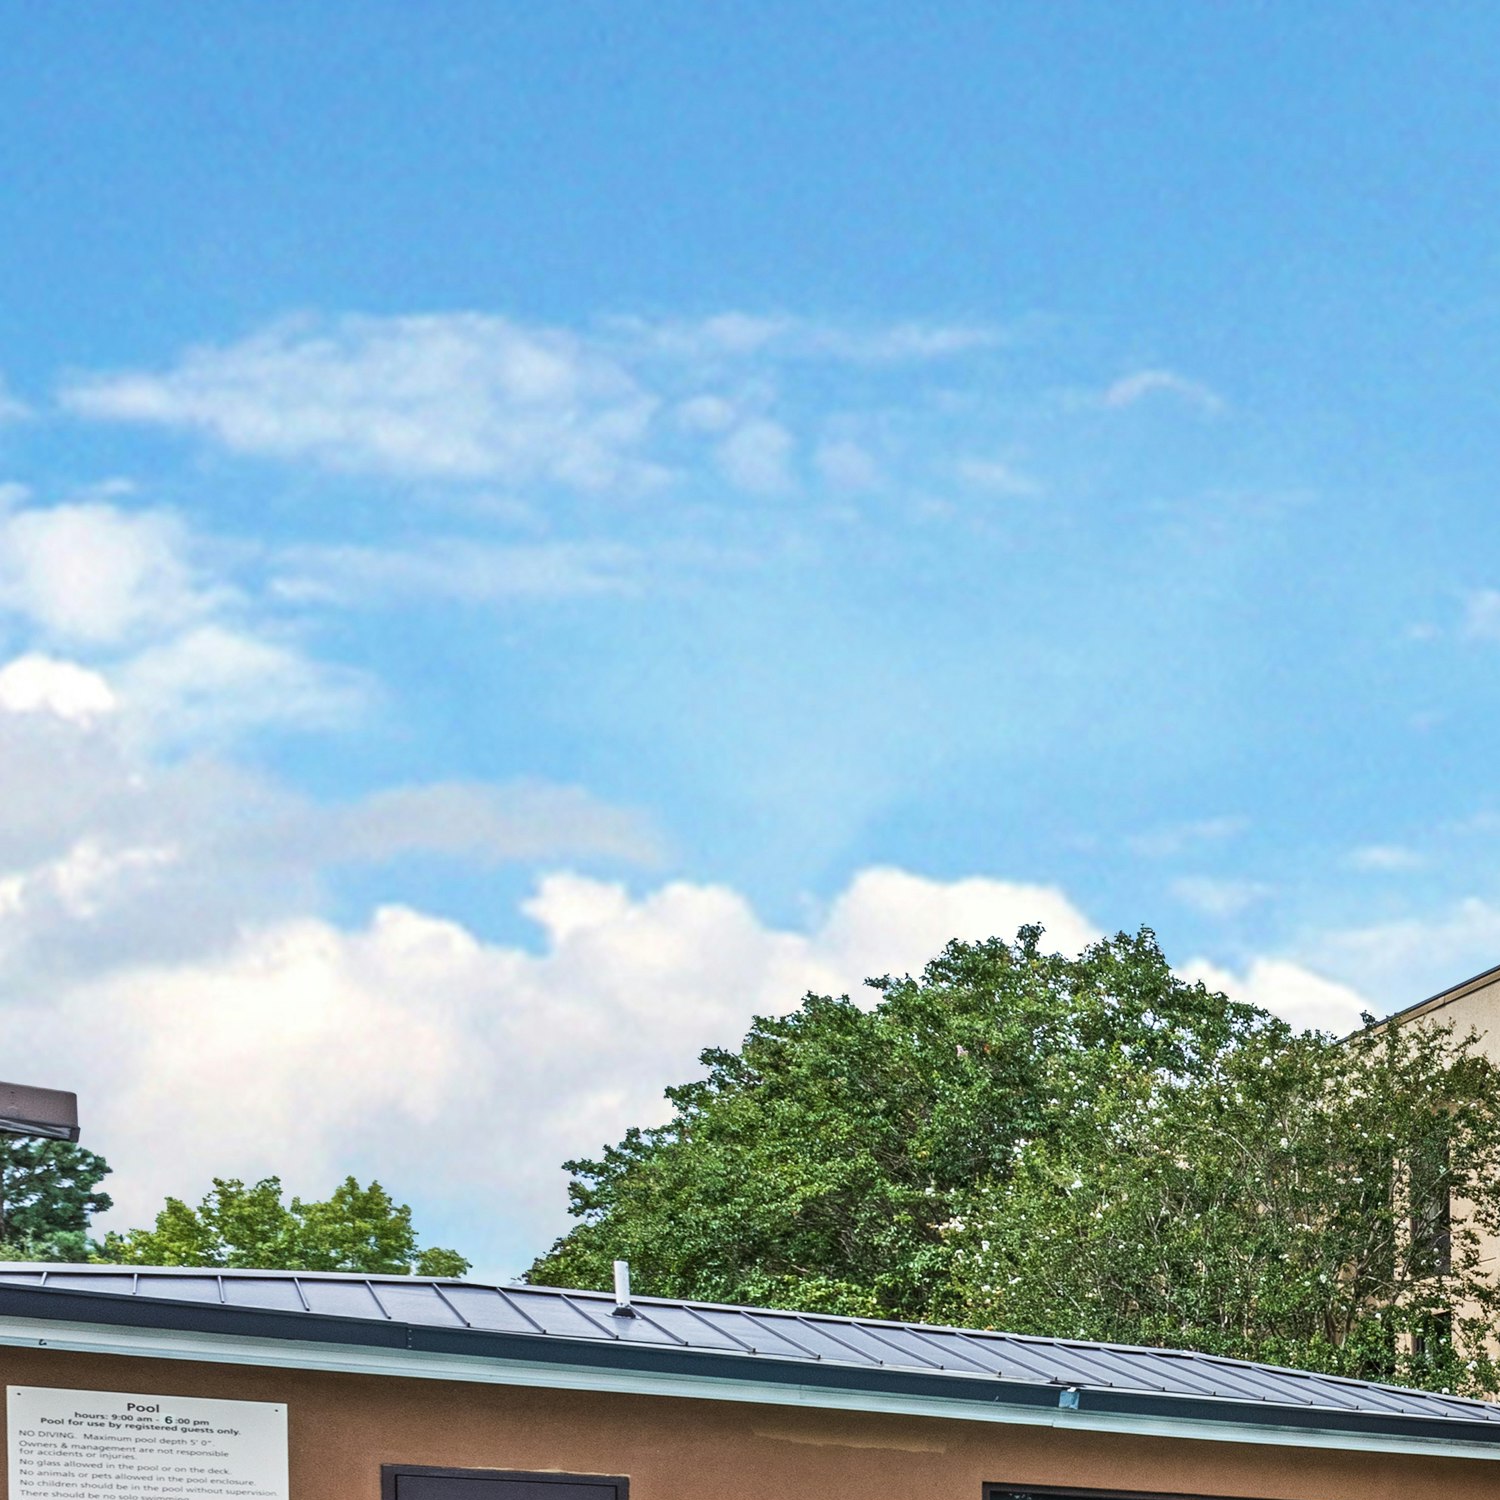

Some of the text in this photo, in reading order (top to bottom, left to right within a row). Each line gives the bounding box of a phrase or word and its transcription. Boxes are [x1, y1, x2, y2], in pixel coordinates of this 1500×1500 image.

[127, 1403, 160, 1413] Pool
[74, 1412, 108, 1420] hours:
[40, 1417, 64, 1425] Pool
[125, 1423, 177, 1431] registered
[217, 1428, 241, 1436] only.
[83, 1433, 132, 1442] Maximum
[135, 1436, 156, 1444] pool
[159, 1437, 187, 1446] depth
[19, 1440, 57, 1448] Owners
[37, 1460, 61, 1468] glass
[64, 1461, 103, 1469] allowed
[37, 1470, 75, 1478] animals
[186, 1486, 223, 1494] without
